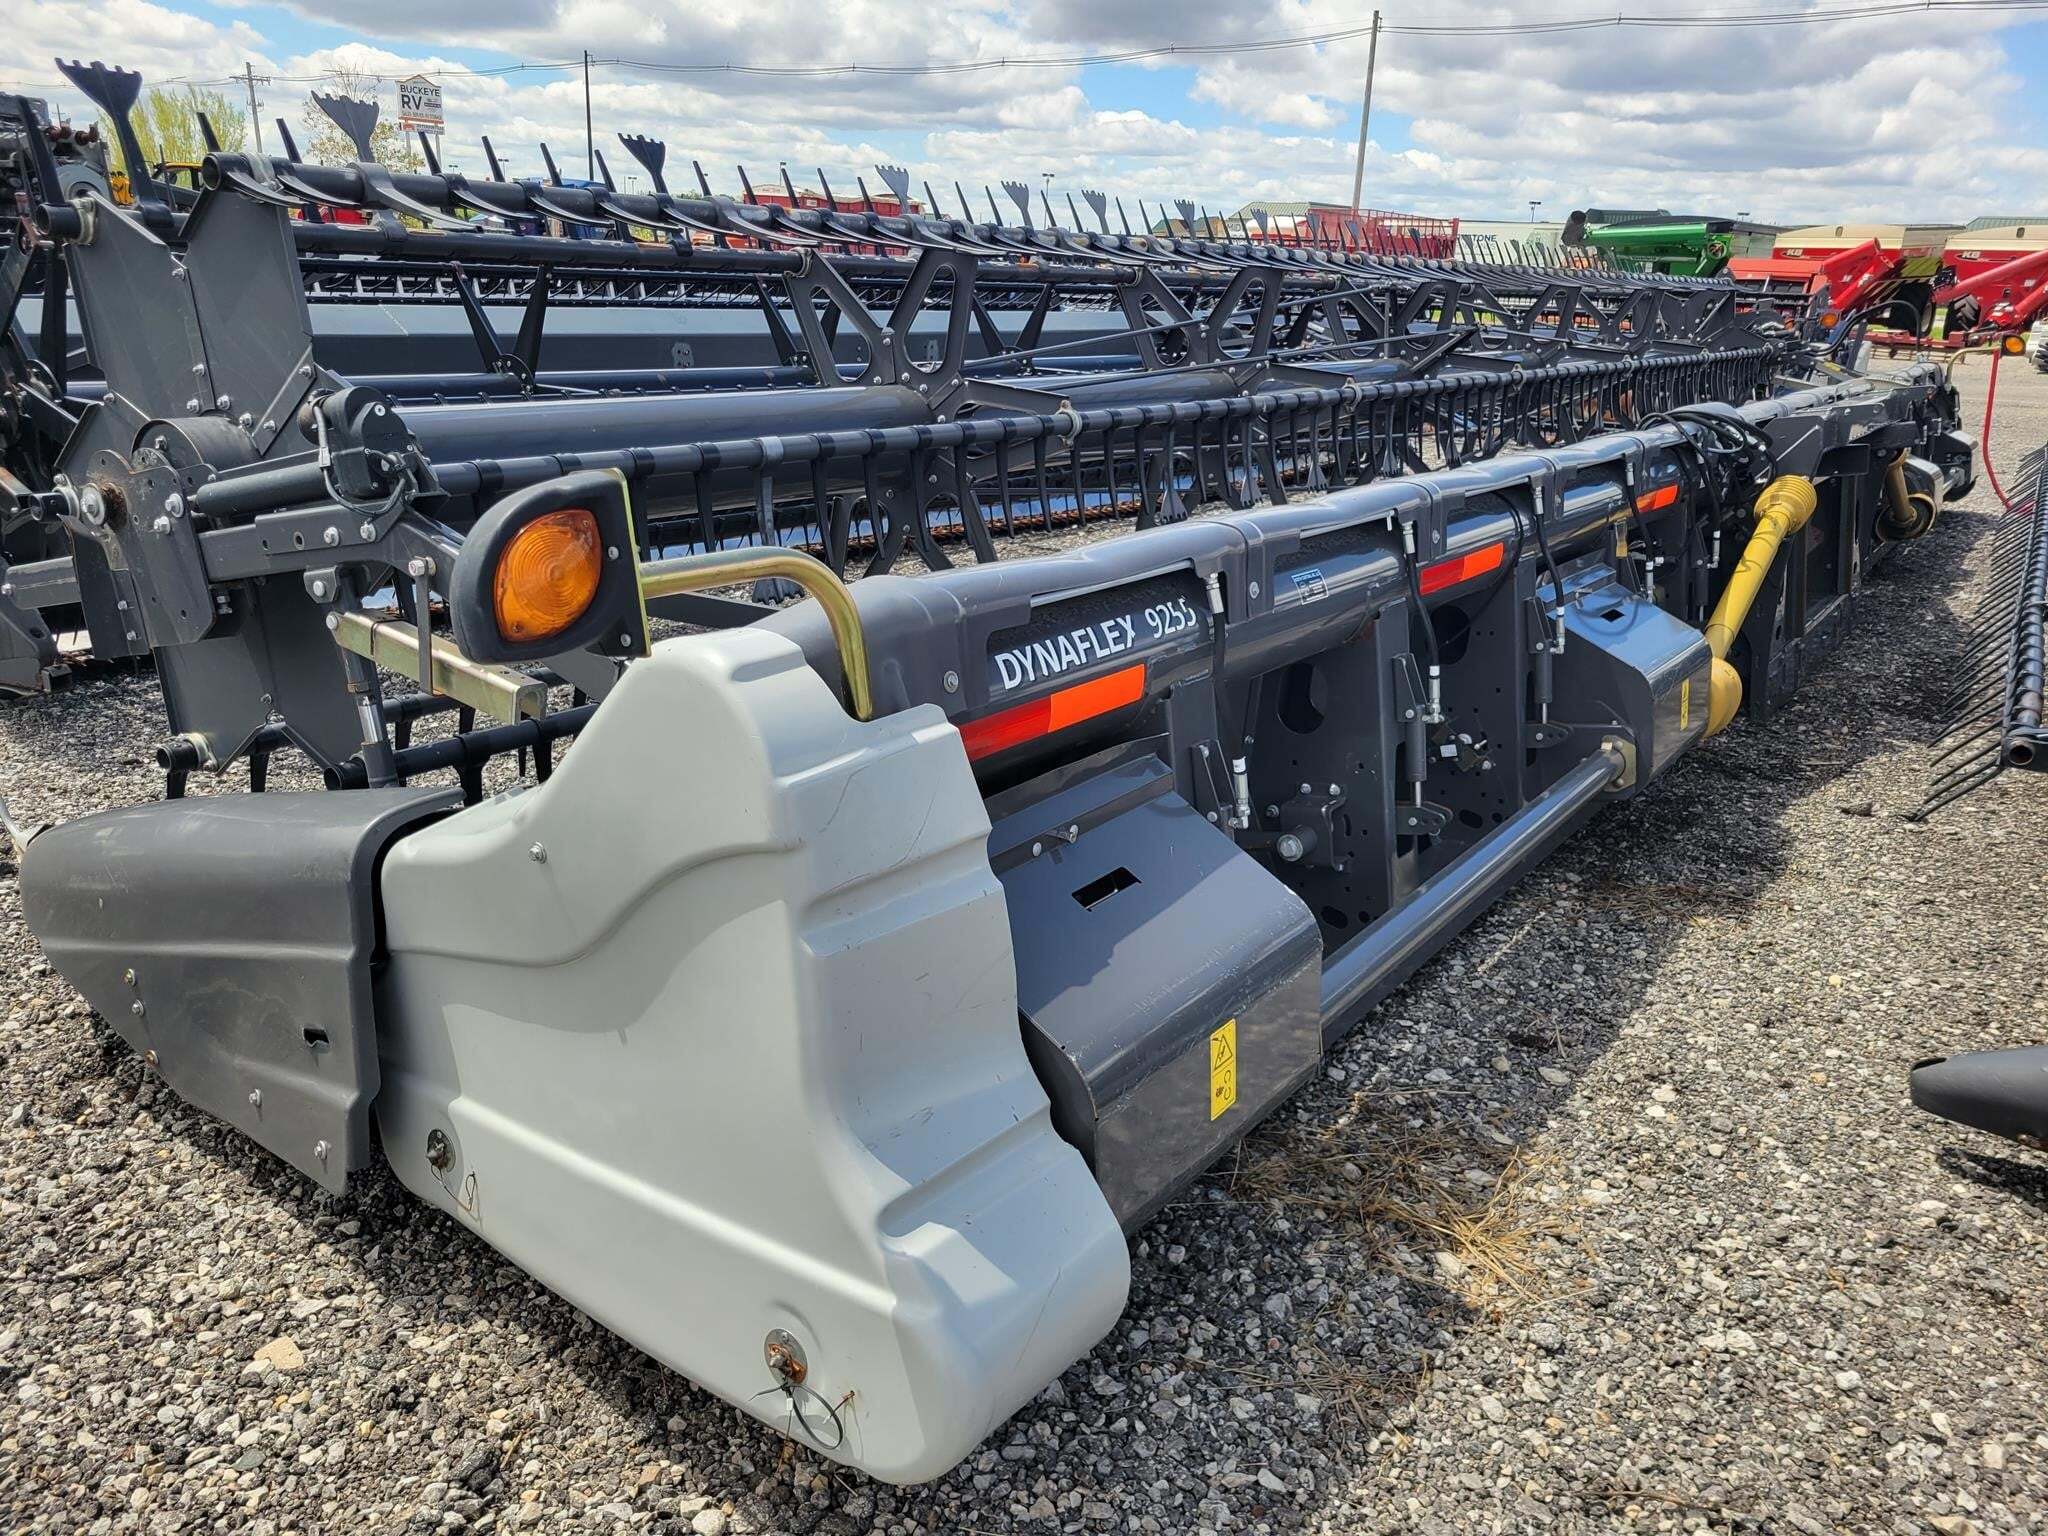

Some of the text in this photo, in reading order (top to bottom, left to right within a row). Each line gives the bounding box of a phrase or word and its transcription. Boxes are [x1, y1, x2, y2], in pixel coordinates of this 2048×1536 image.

[400, 84, 440, 97] BUCKEYE
[401, 94, 422, 110] RV
[994, 595, 1198, 691] DYNAFLEX 9255
